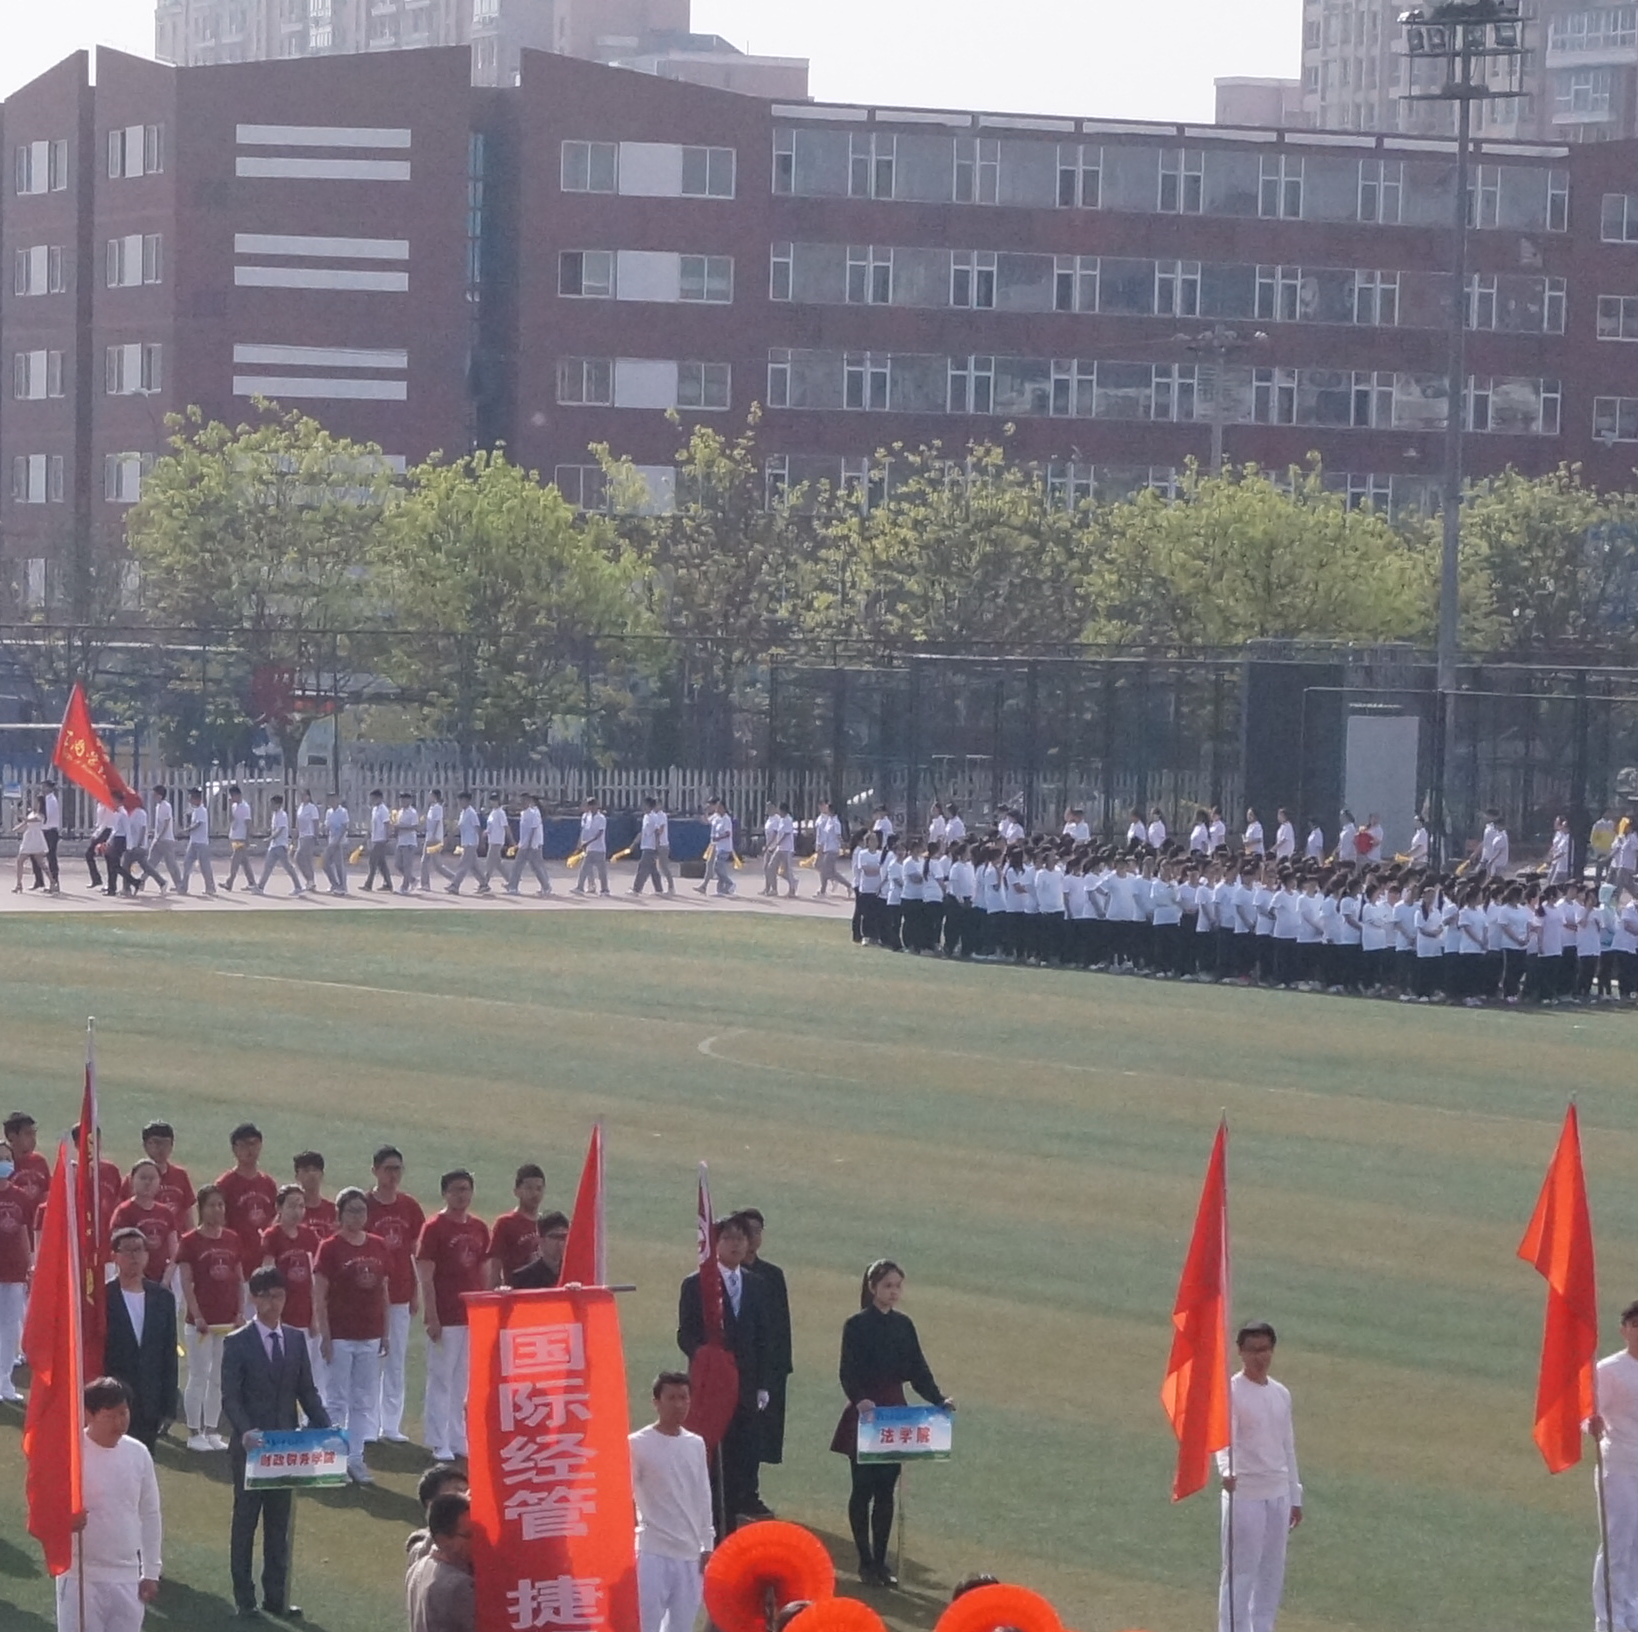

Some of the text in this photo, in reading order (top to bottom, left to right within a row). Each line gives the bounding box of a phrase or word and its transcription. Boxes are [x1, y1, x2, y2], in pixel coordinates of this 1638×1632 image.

[497, 1321, 597, 1542] 国际经管
[879, 1426, 931, 1444] 法学院
